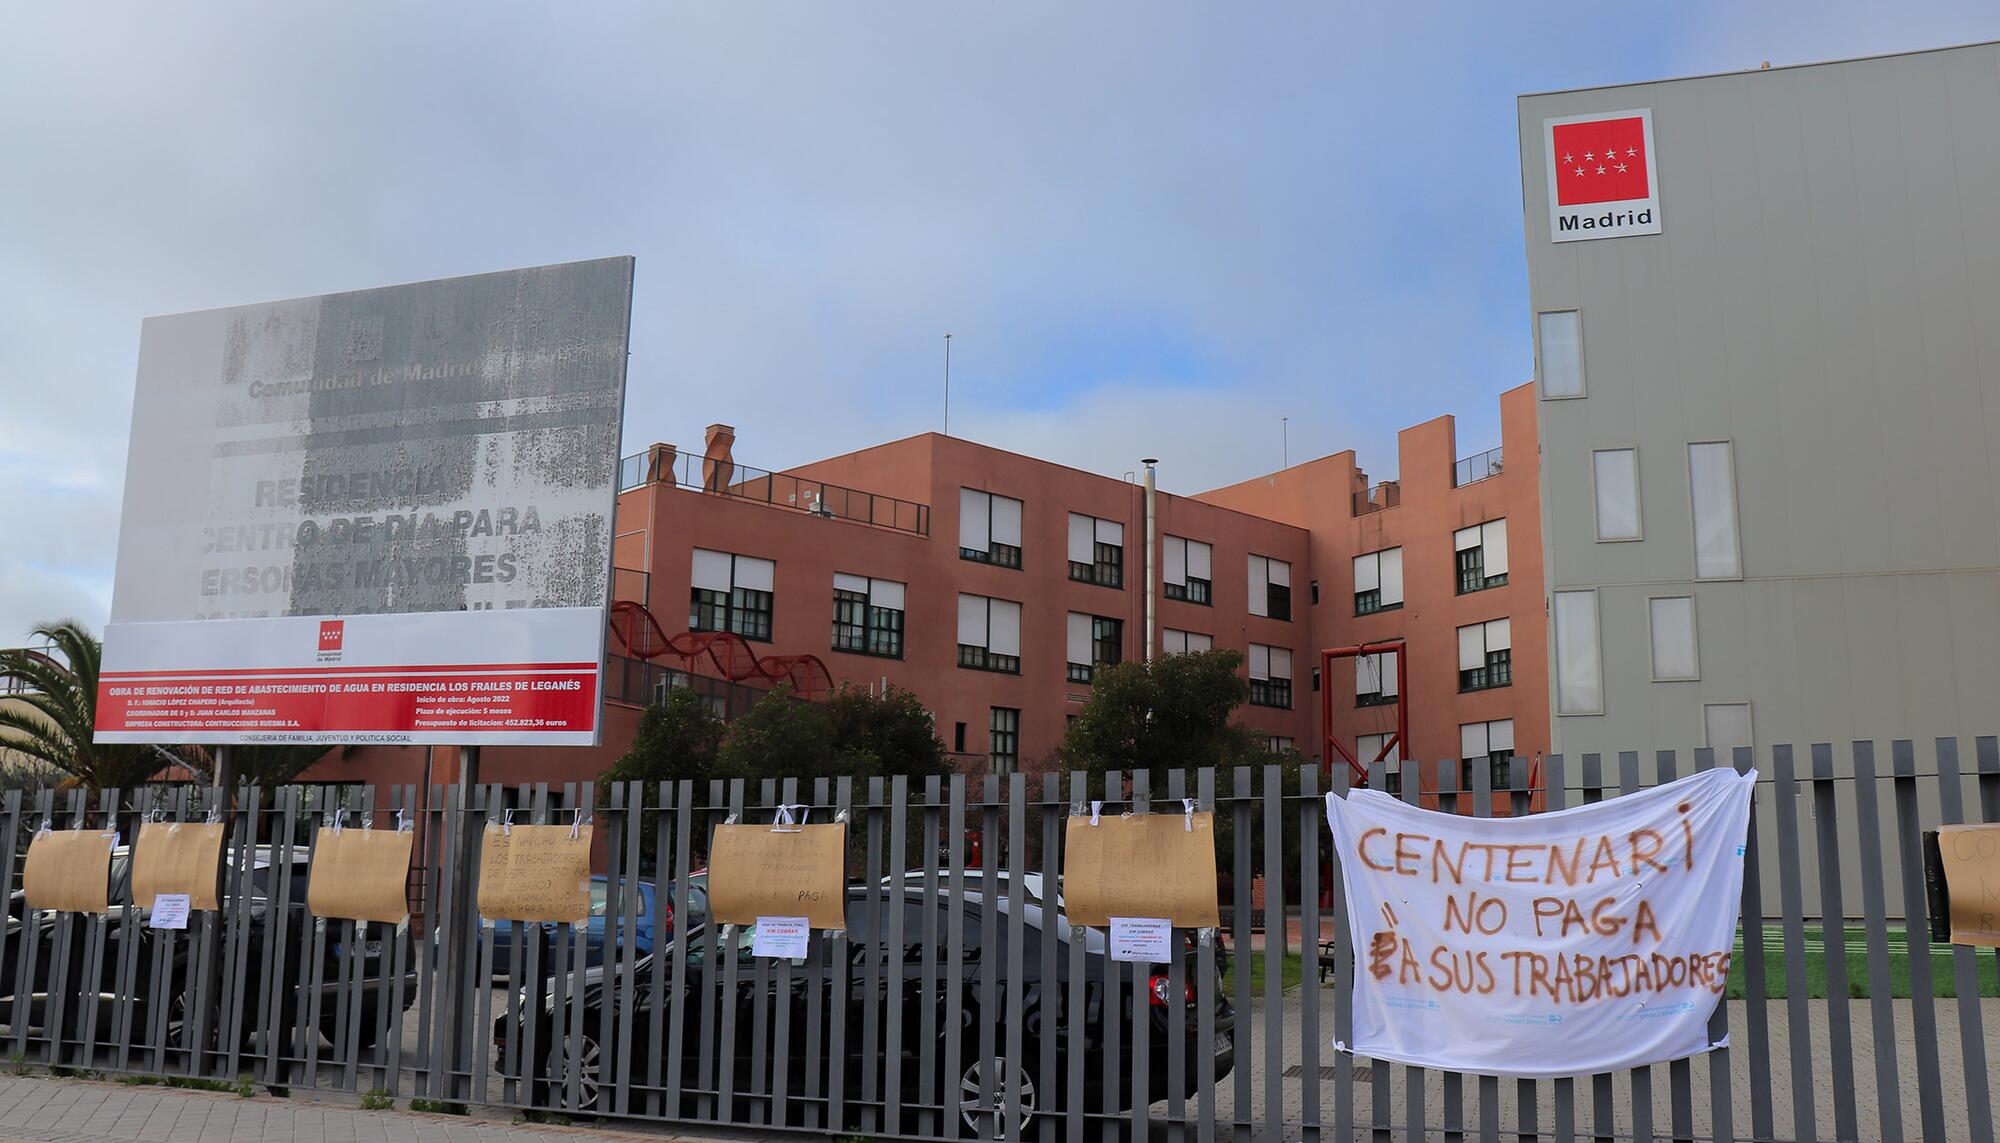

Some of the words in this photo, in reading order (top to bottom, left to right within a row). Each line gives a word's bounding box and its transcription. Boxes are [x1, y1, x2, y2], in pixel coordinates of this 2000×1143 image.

[1560, 209, 1652, 231] Madrid
[250, 373, 361, 399] Comunidad
[370, 368, 393, 386] de
[403, 359, 480, 383] Madrid
[255, 468, 446, 507] RESIDENCIA
[331, 517, 374, 545] DE
[384, 506, 438, 542] DÍA
[453, 506, 542, 539] PARA
[201, 562, 343, 597] ERSONAS
[355, 552, 517, 589] MAYORES
[110, 687, 132, 696] OBRA
[134, 687, 144, 695] DE
[146, 684, 199, 695] RENOVACIÓN
[201, 686, 212, 694] DE
[215, 686, 234, 694] RED
[236, 686, 247, 694] DE
[249, 684, 326, 694] ABASTECIMIENTO
[329, 684, 341, 692] DE
[343, 684, 368, 692] AGUA
[372, 684, 384, 692] EN
[387, 682, 446, 692] RESIDENCIA
[449, 682, 468, 691] LOS
[470, 682, 512, 691] FRAILES
[514, 681, 528, 690] DE
[531, 679, 581, 690] LEGANÉS
[446, 708, 482, 716] ejecución:
[488, 868, 500, 879] DE
[504, 868, 527, 880] ESTE
[490, 852, 508, 866] LOS
[517, 904, 545, 914] PARA
[1444, 891, 1508, 935] NO
[1533, 896, 1662, 944] PAGA
[1429, 945, 1496, 995] SUS
[1501, 950, 1731, 1004] TRABAJADORES
